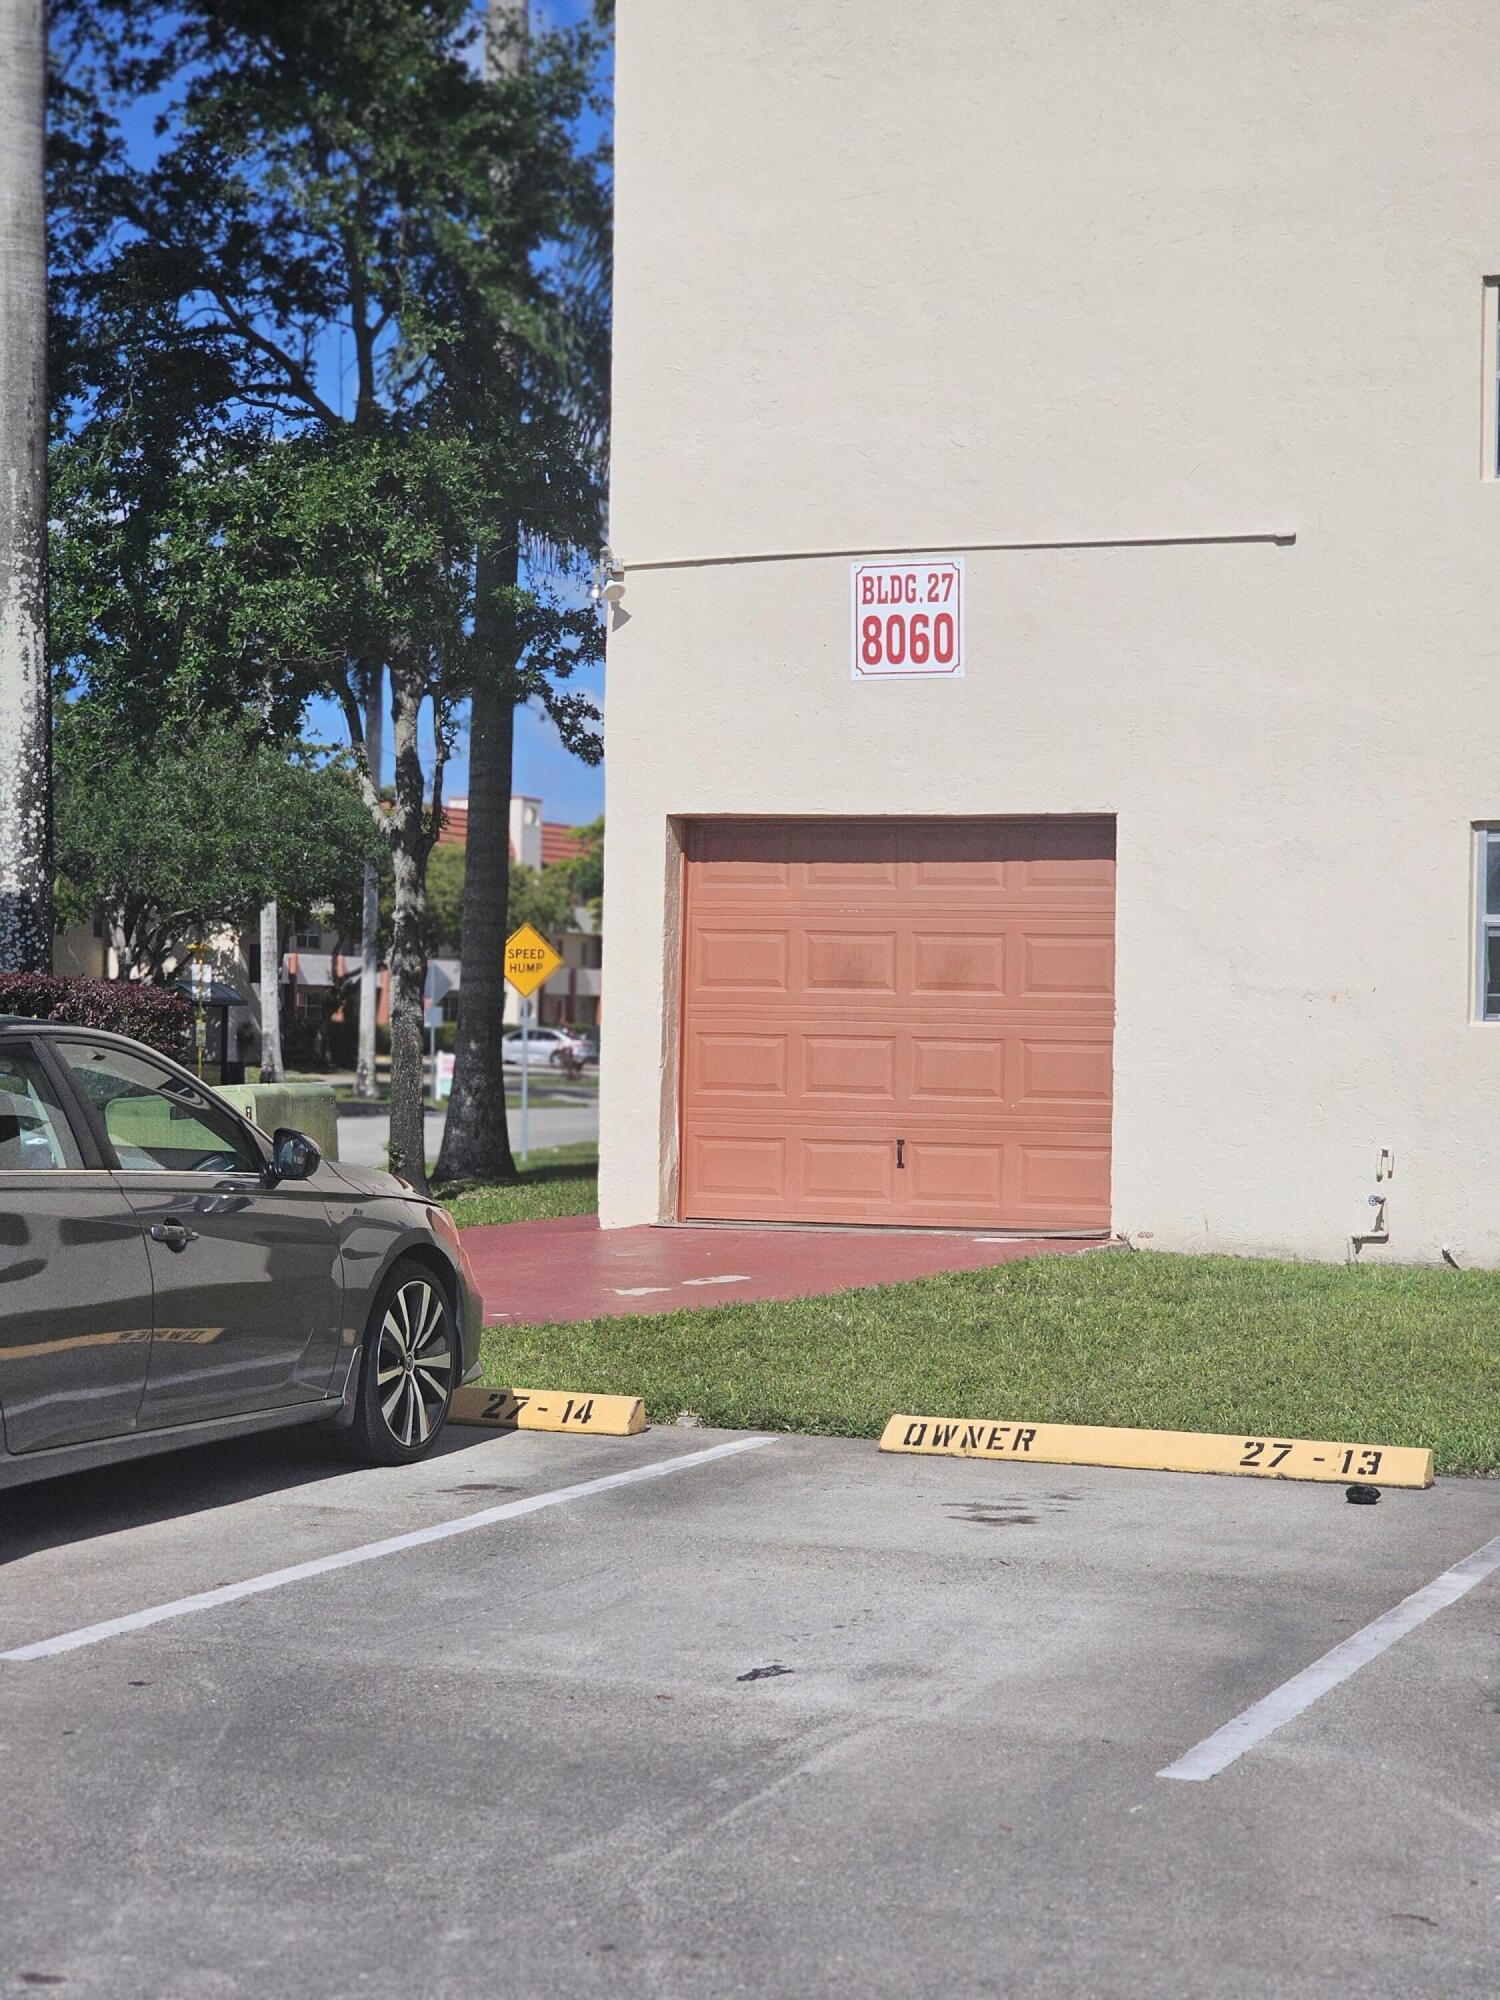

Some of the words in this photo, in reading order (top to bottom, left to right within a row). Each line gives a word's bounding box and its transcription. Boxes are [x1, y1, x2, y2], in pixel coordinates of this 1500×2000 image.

[862, 612, 954, 665] 8060
[508, 948, 545, 960] SPEED
[509, 963, 544, 973] HUMP
[903, 1423, 1037, 1452] OWNER
